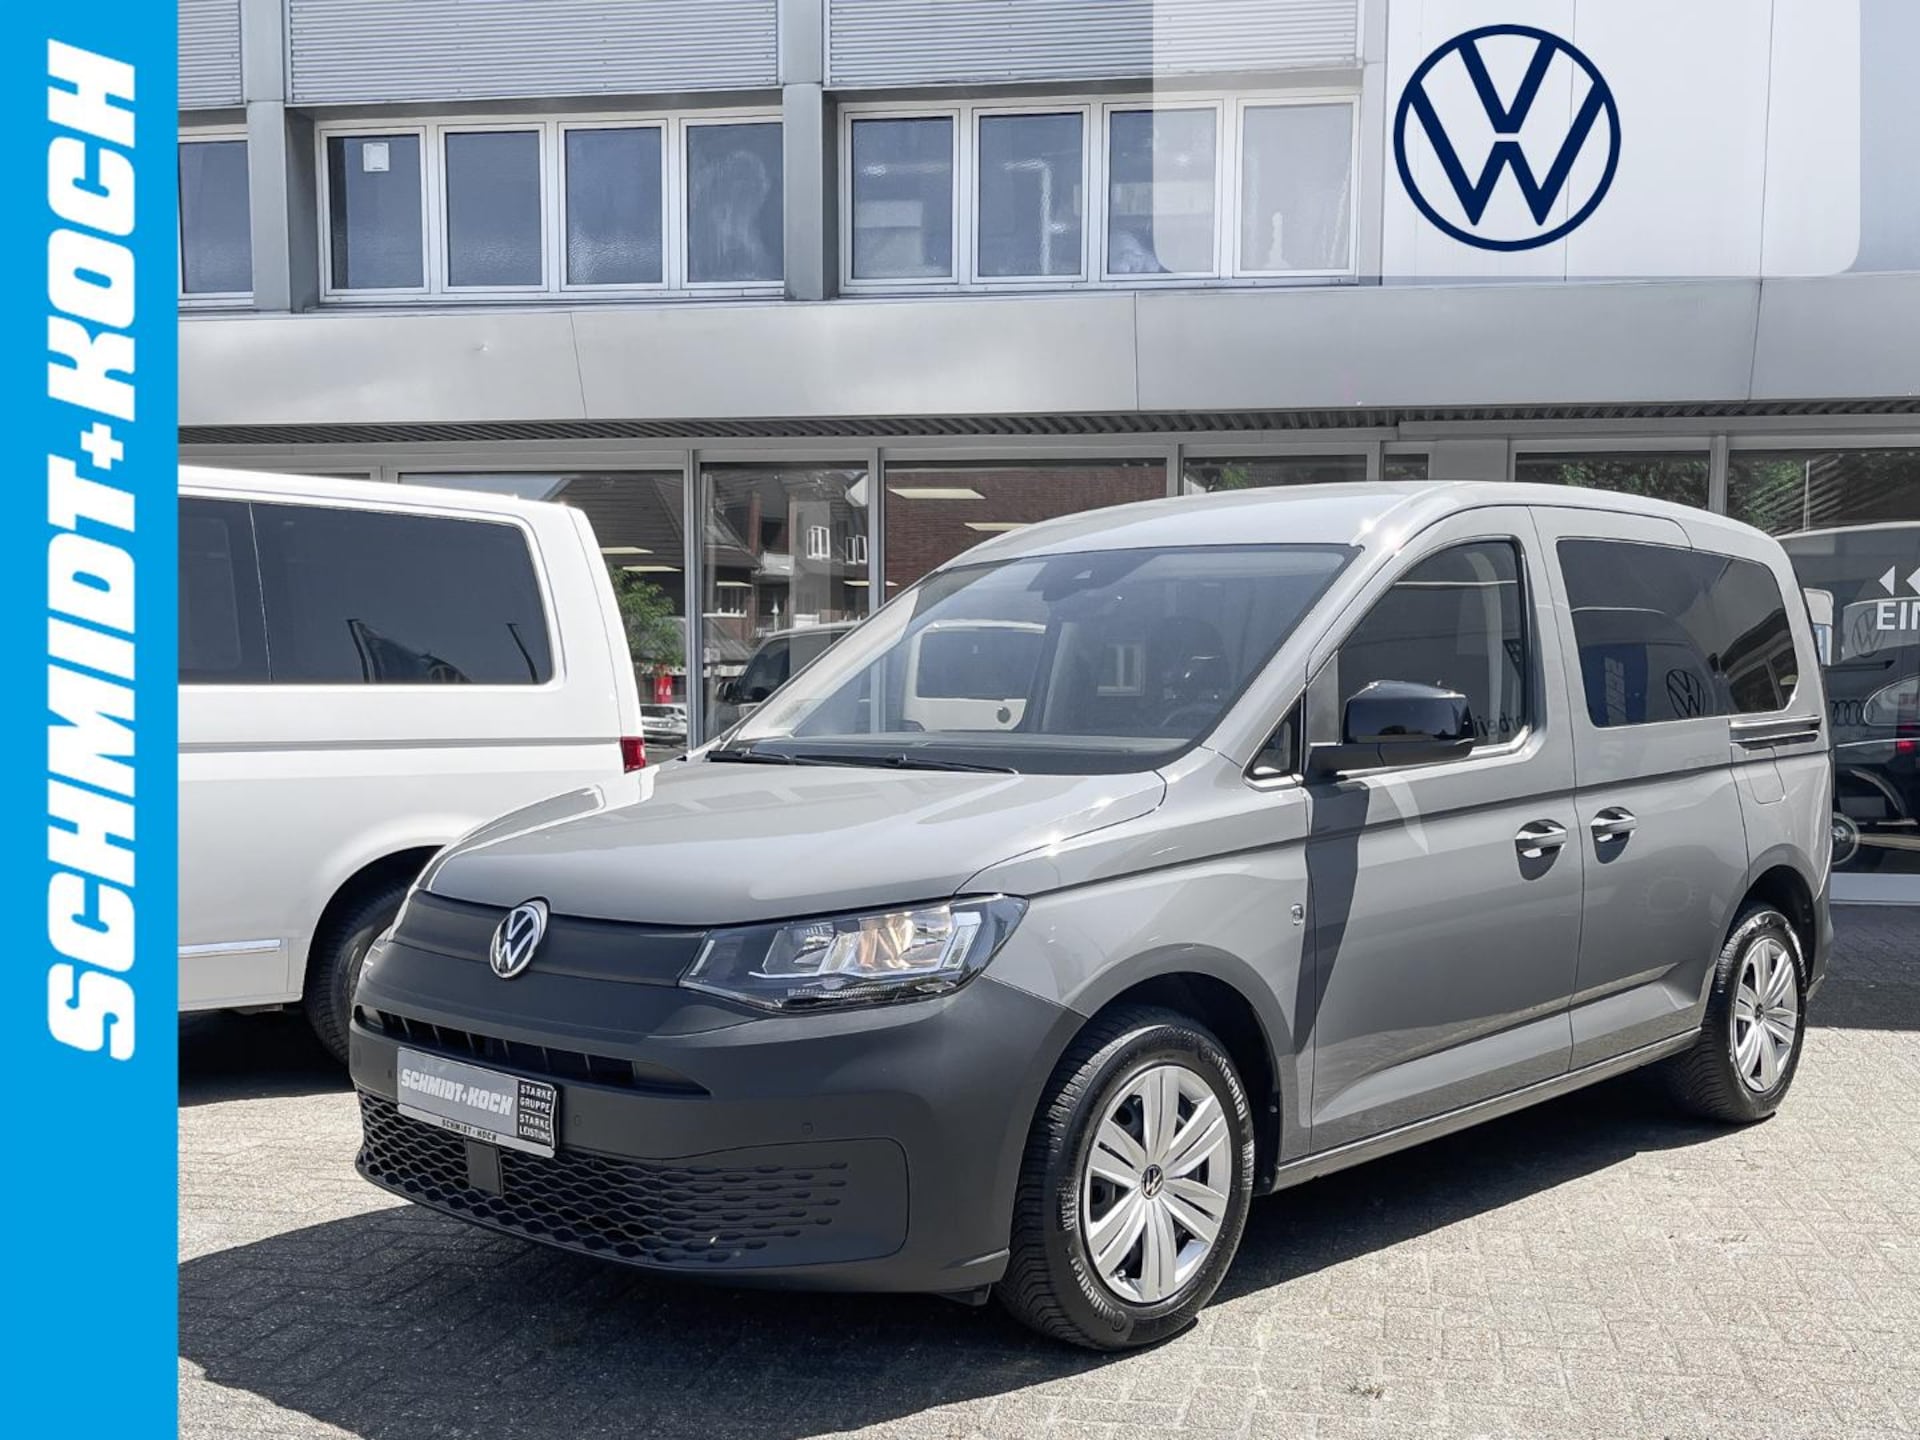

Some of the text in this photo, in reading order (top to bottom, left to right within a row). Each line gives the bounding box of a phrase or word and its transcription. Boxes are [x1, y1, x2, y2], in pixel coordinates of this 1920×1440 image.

[519, 1083, 553, 1101] STARKE
[519, 1096, 551, 1114] GRUPPE
[518, 1112, 551, 1131] STARKE
